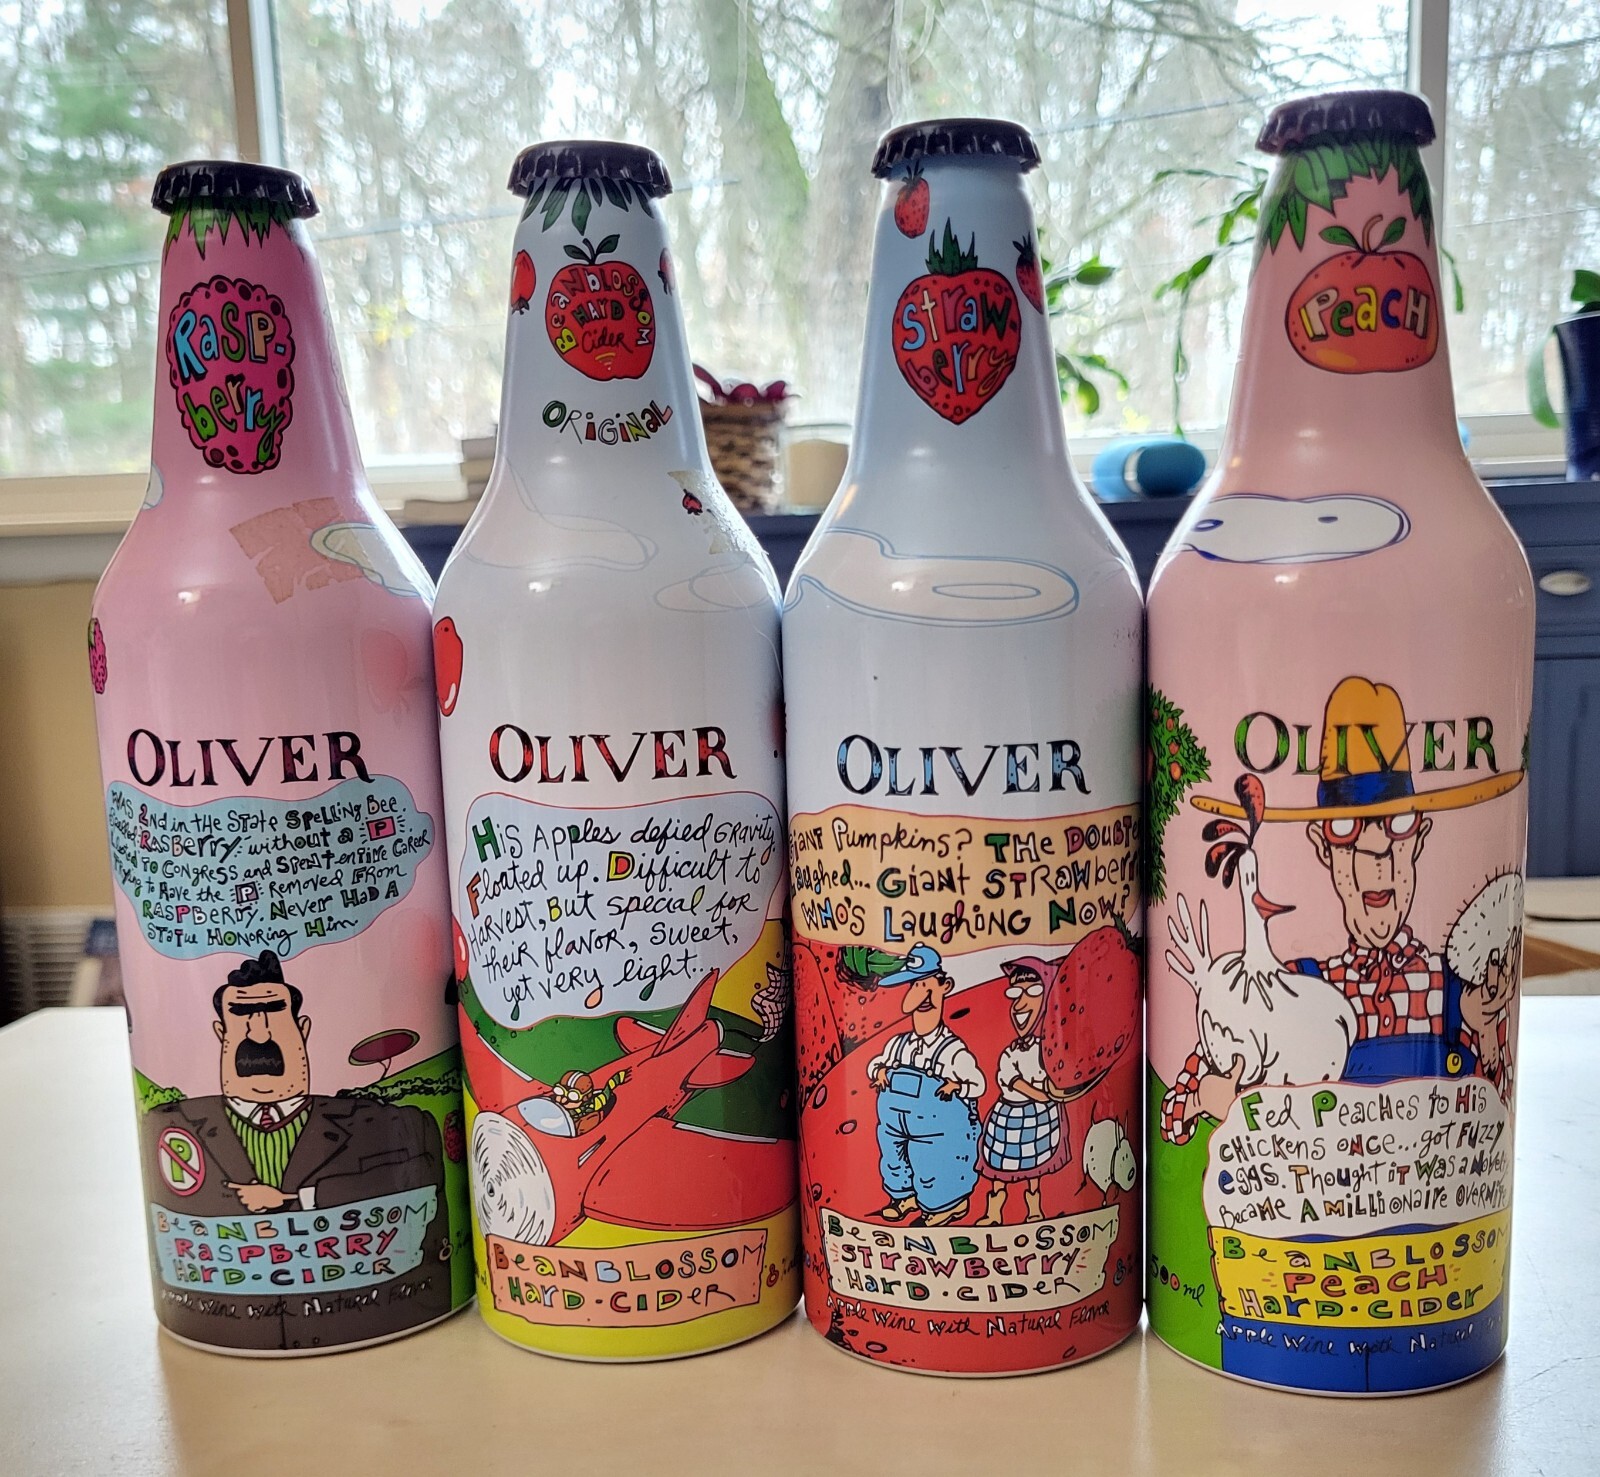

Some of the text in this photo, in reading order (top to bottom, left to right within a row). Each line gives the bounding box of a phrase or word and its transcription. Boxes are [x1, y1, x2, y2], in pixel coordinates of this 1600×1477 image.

[183, 372, 286, 465] berry
[127, 728, 375, 787] OLIVER
[489, 724, 737, 783] OLIVER
[836, 734, 1092, 797] OLIVER
[1234, 711, 1500, 774] OLIVER
[170, 818, 191, 833] in
[248, 827, 331, 855] without
[533, 817, 621, 860] Apples
[630, 812, 714, 852] defied
[831, 815, 973, 863] Pumpkins?
[244, 859, 272, 880] and
[385, 880, 399, 899] A
[466, 860, 547, 920] Floated
[606, 848, 732, 893] Difficult
[735, 846, 760, 884] to
[196, 885, 225, 902] the
[547, 890, 597, 923] But
[606, 884, 707, 930] special
[502, 974, 534, 1021] yet
[1240, 1091, 1300, 1132] Fed
[1429, 1084, 1449, 1119] to
[169, 1138, 192, 1183] P
[1419, 1120, 1456, 1159] got
[1288, 1161, 1387, 1193] Thought
[1300, 1198, 1320, 1223] A
[871, 1308, 921, 1334] Wine
